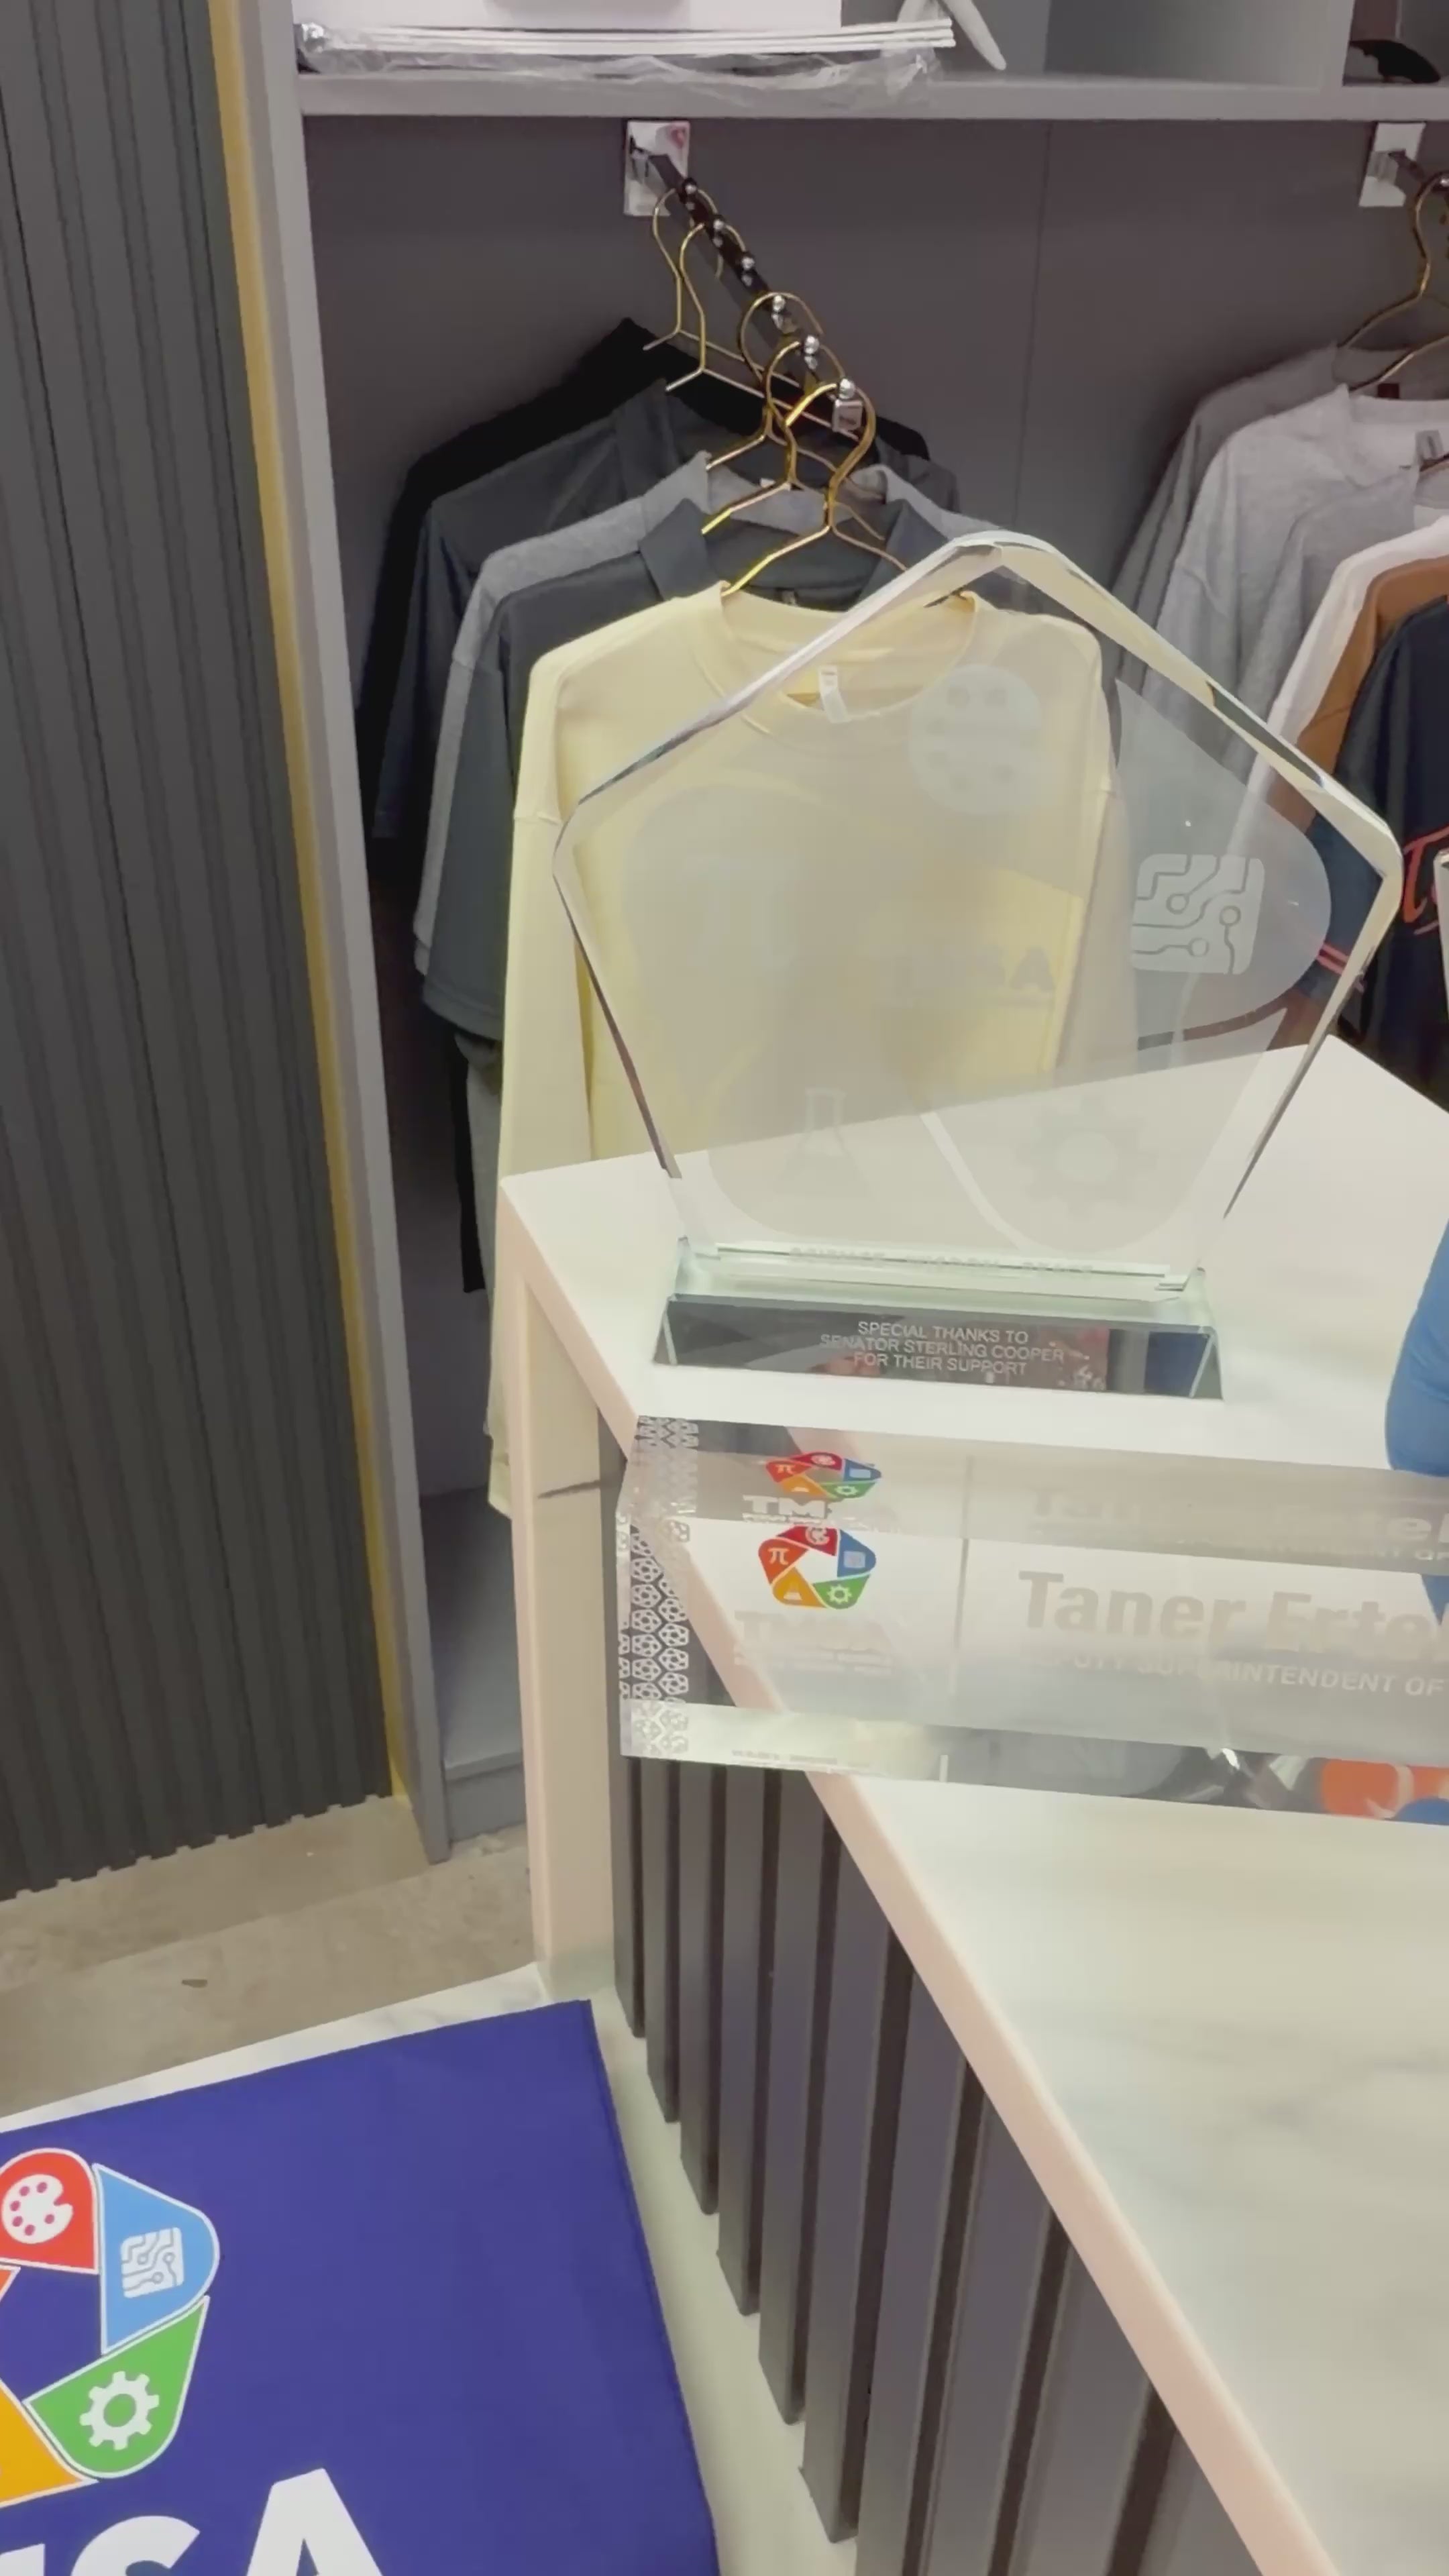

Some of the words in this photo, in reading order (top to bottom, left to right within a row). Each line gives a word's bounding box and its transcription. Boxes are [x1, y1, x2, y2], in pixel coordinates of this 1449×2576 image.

[820, 1333, 901, 1352] SENATOR
[904, 1339, 988, 1359] STERLING
[991, 1344, 1065, 1364] COOPER
[858, 1321, 928, 1340] SPECIAL
[932, 1326, 1000, 1343] THANKS
[1006, 1330, 1029, 1345] TO
[853, 1350, 889, 1367] FOR
[893, 1354, 943, 1371] THEIR
[946, 1357, 1028, 1375] SUPPORT
[1018, 1570, 1247, 1647] Taner
[1137, 1650, 1396, 1693] SUPINTENDENT
